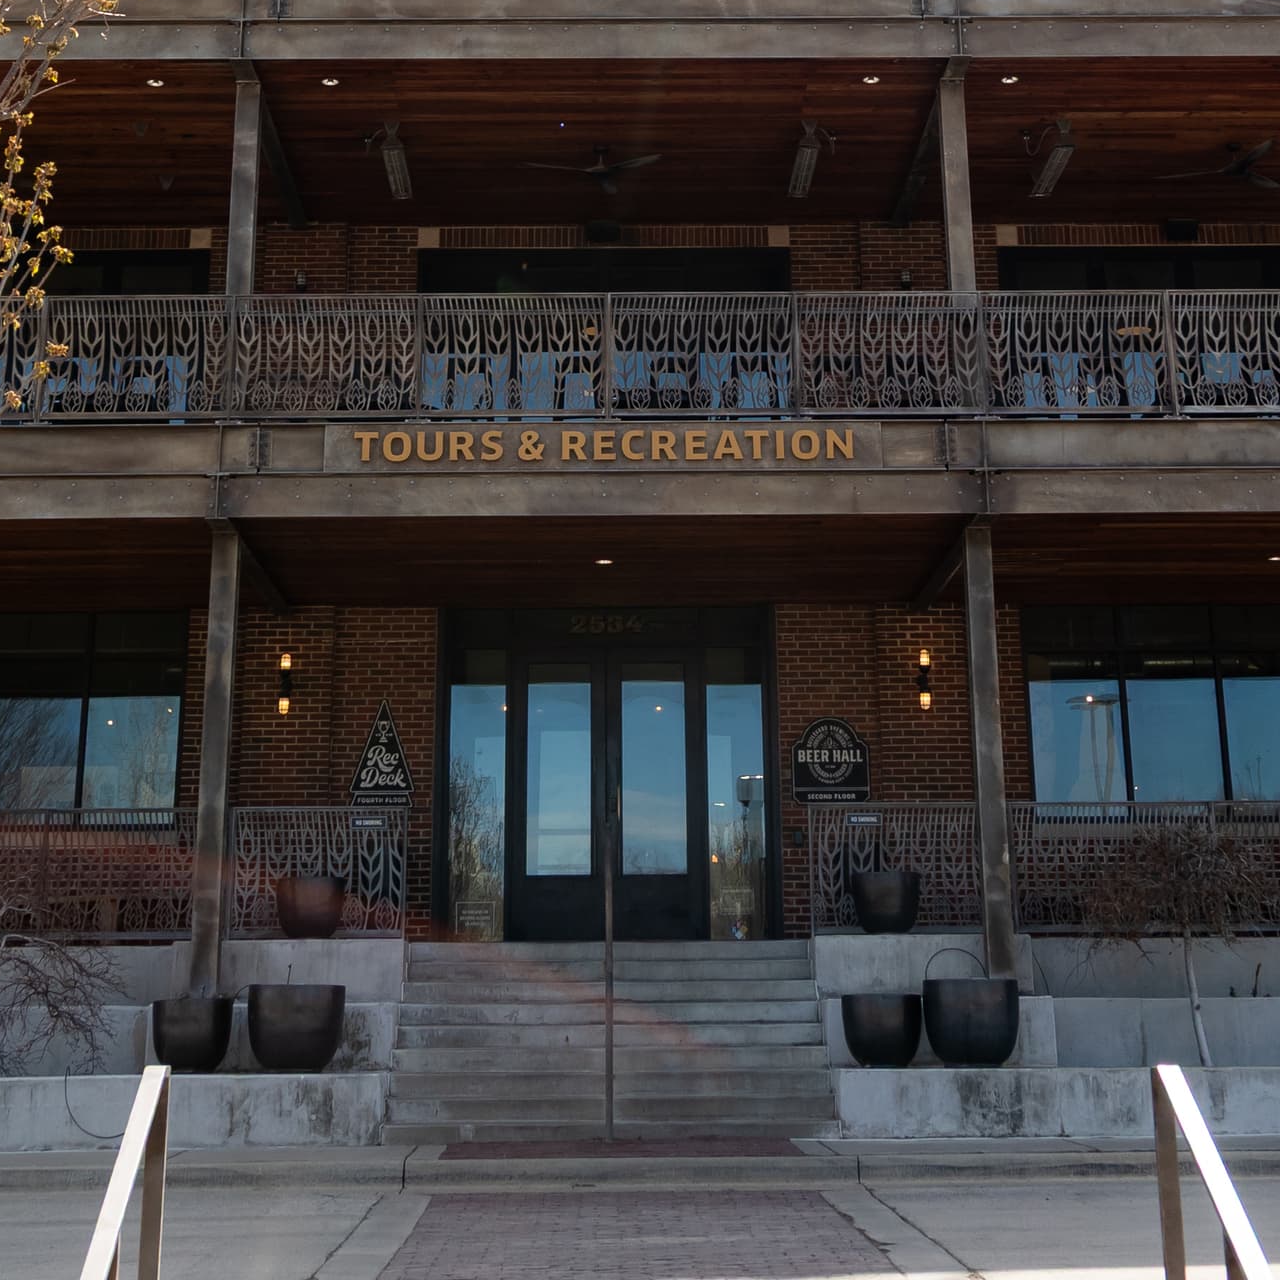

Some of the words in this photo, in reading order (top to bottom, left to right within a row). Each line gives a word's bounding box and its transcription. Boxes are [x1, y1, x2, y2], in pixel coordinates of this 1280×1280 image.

[354, 429, 504, 462] TOURS
[518, 429, 546, 462] &
[560, 428, 856, 461] RECREATION
[367, 745, 400, 773] Rec
[798, 749, 830, 763] BEER
[832, 749, 864, 763] HALL
[360, 766, 407, 788] Deck
